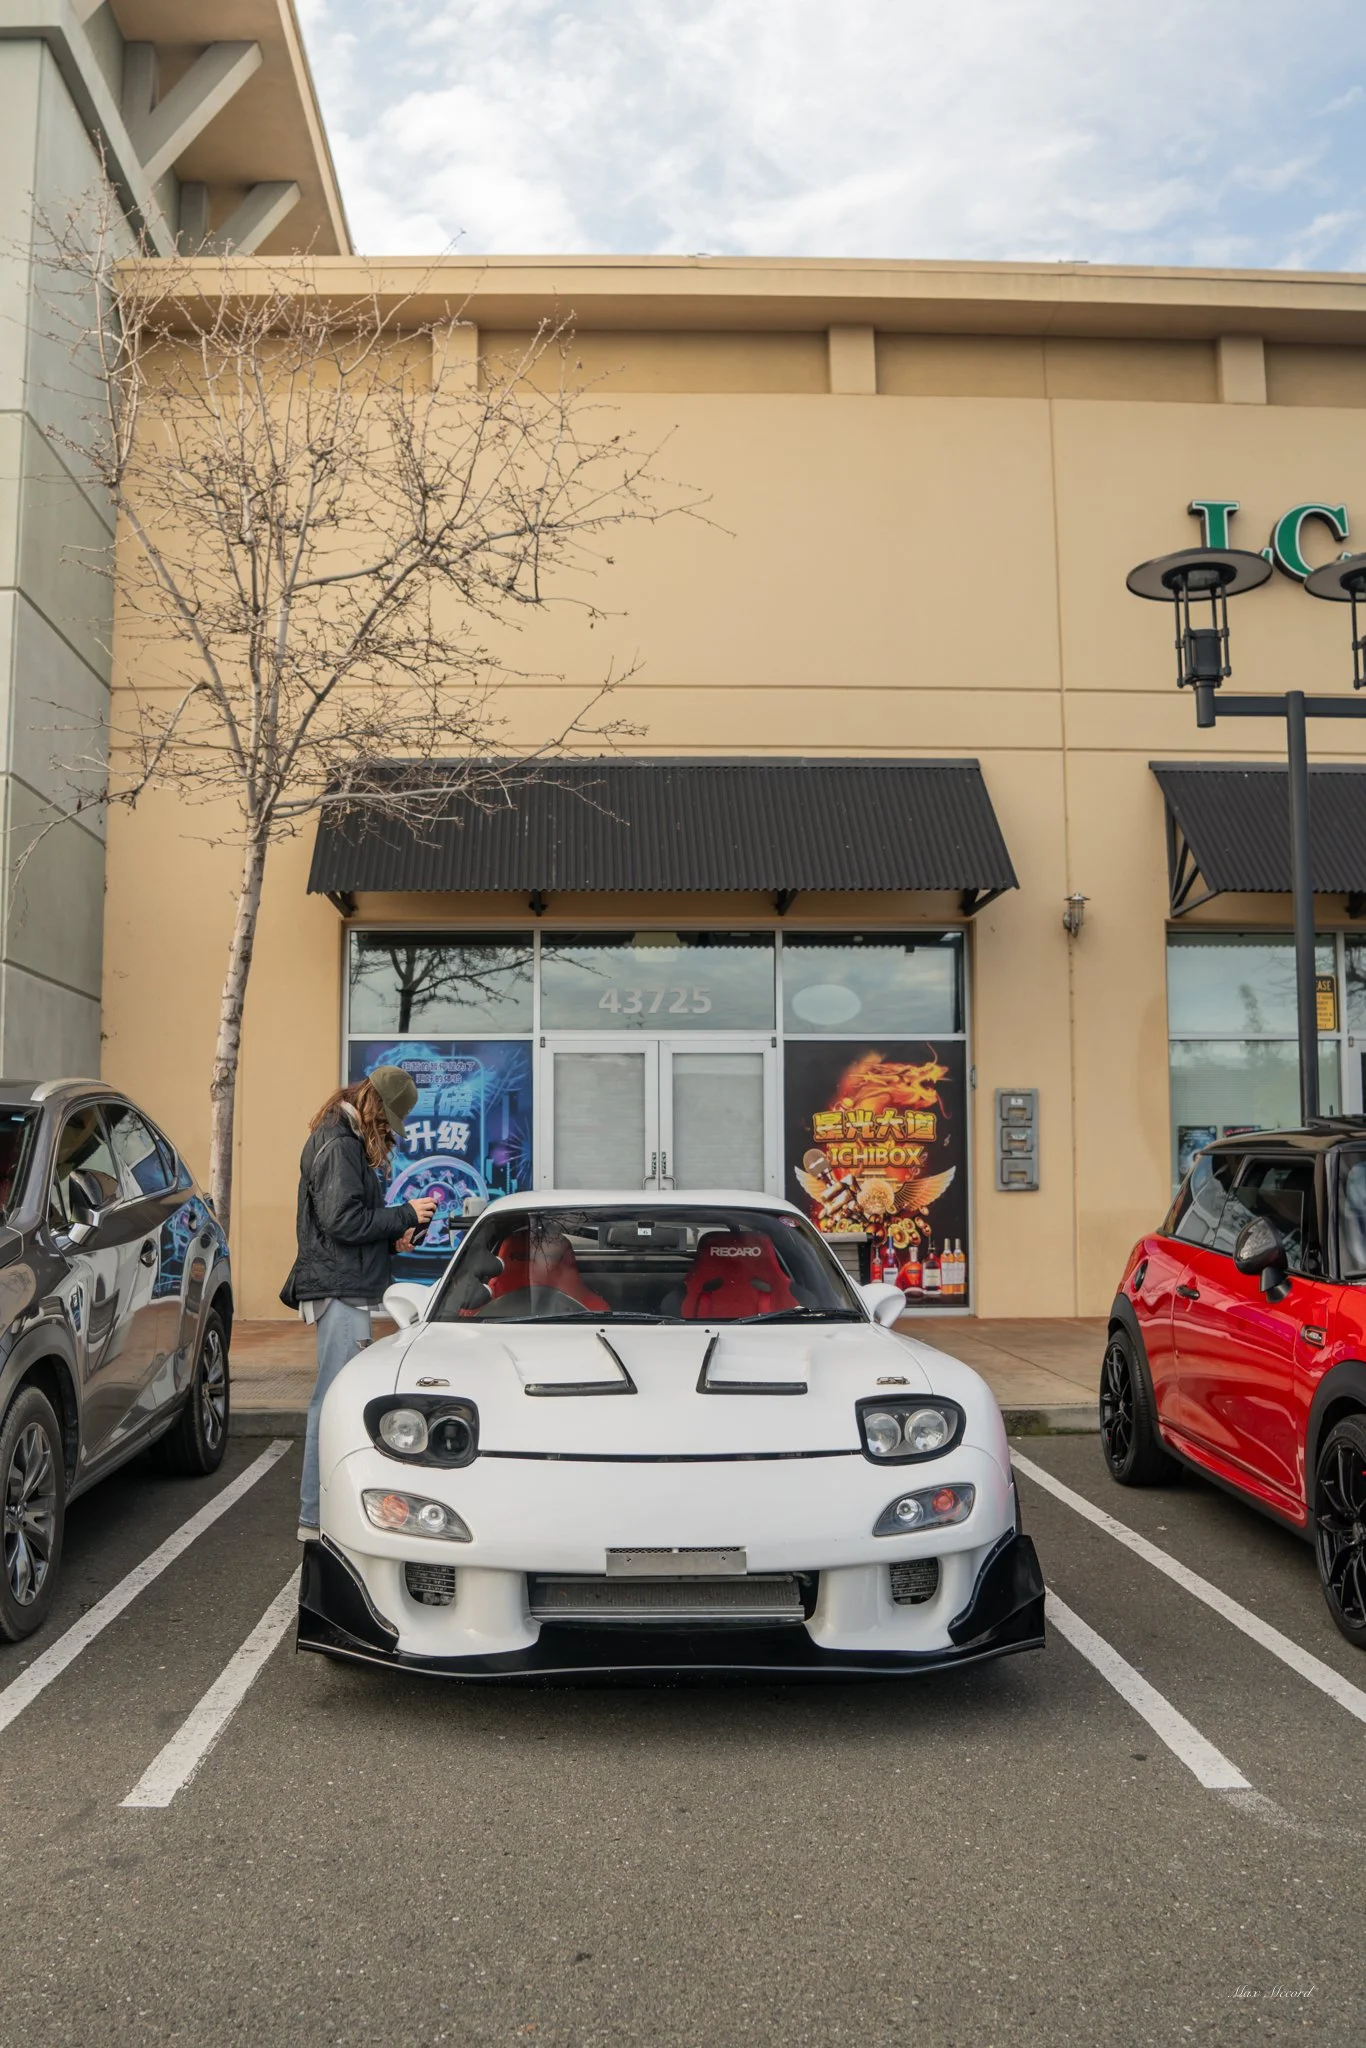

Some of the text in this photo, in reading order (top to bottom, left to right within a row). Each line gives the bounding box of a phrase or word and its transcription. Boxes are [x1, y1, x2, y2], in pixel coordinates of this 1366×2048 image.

[598, 986, 712, 1015] 43725
[416, 1073, 463, 1084] 更好的体验
[404, 1120, 471, 1153] 升级
[813, 1108, 937, 1142] 星光大道
[829, 1146, 924, 1167] ICHIBOX
[710, 1246, 762, 1257] RECARO
